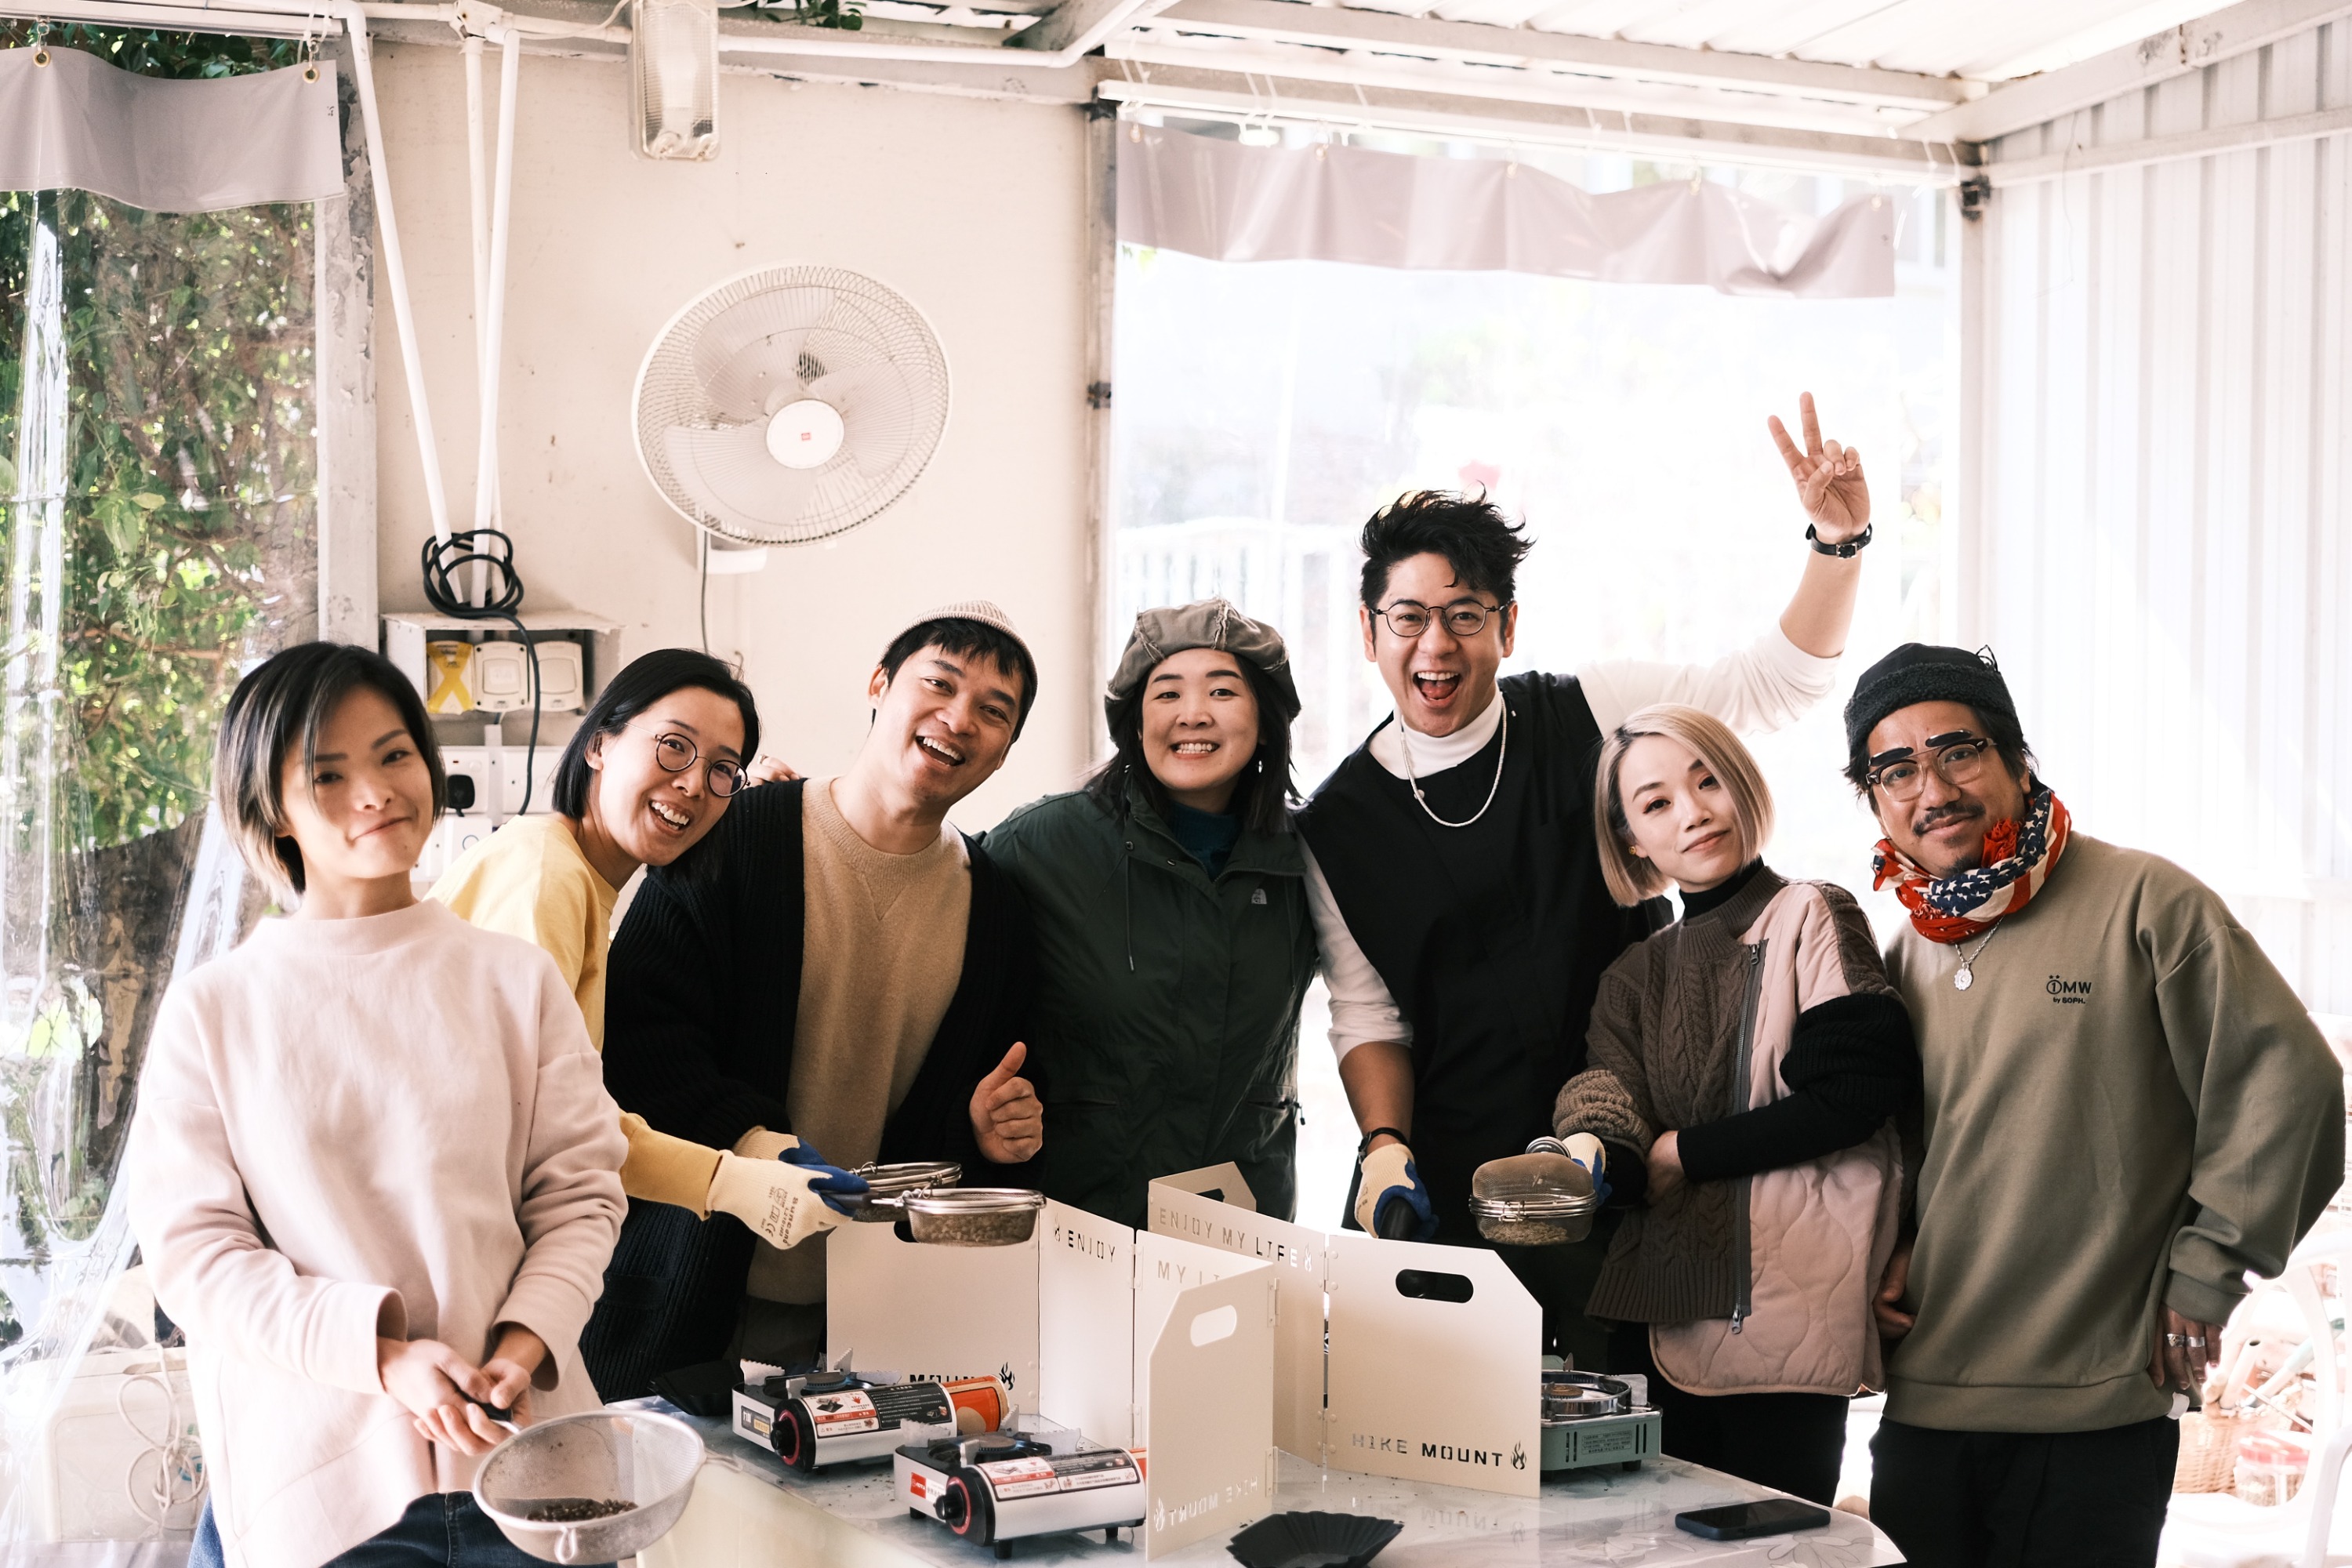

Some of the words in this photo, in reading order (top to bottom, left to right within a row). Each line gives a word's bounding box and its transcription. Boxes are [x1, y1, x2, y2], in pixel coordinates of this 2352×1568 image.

[1068, 1229, 1116, 1263] ENJOY
[1158, 1260, 1186, 1284] MY
[1160, 1207, 1213, 1240] ENJOY
[1222, 1227, 1246, 1249] MY
[1256, 1236, 1298, 1268] LIFE
[1352, 1433, 1407, 1454] HIKE
[1421, 1443, 1503, 1467] MOUNT
